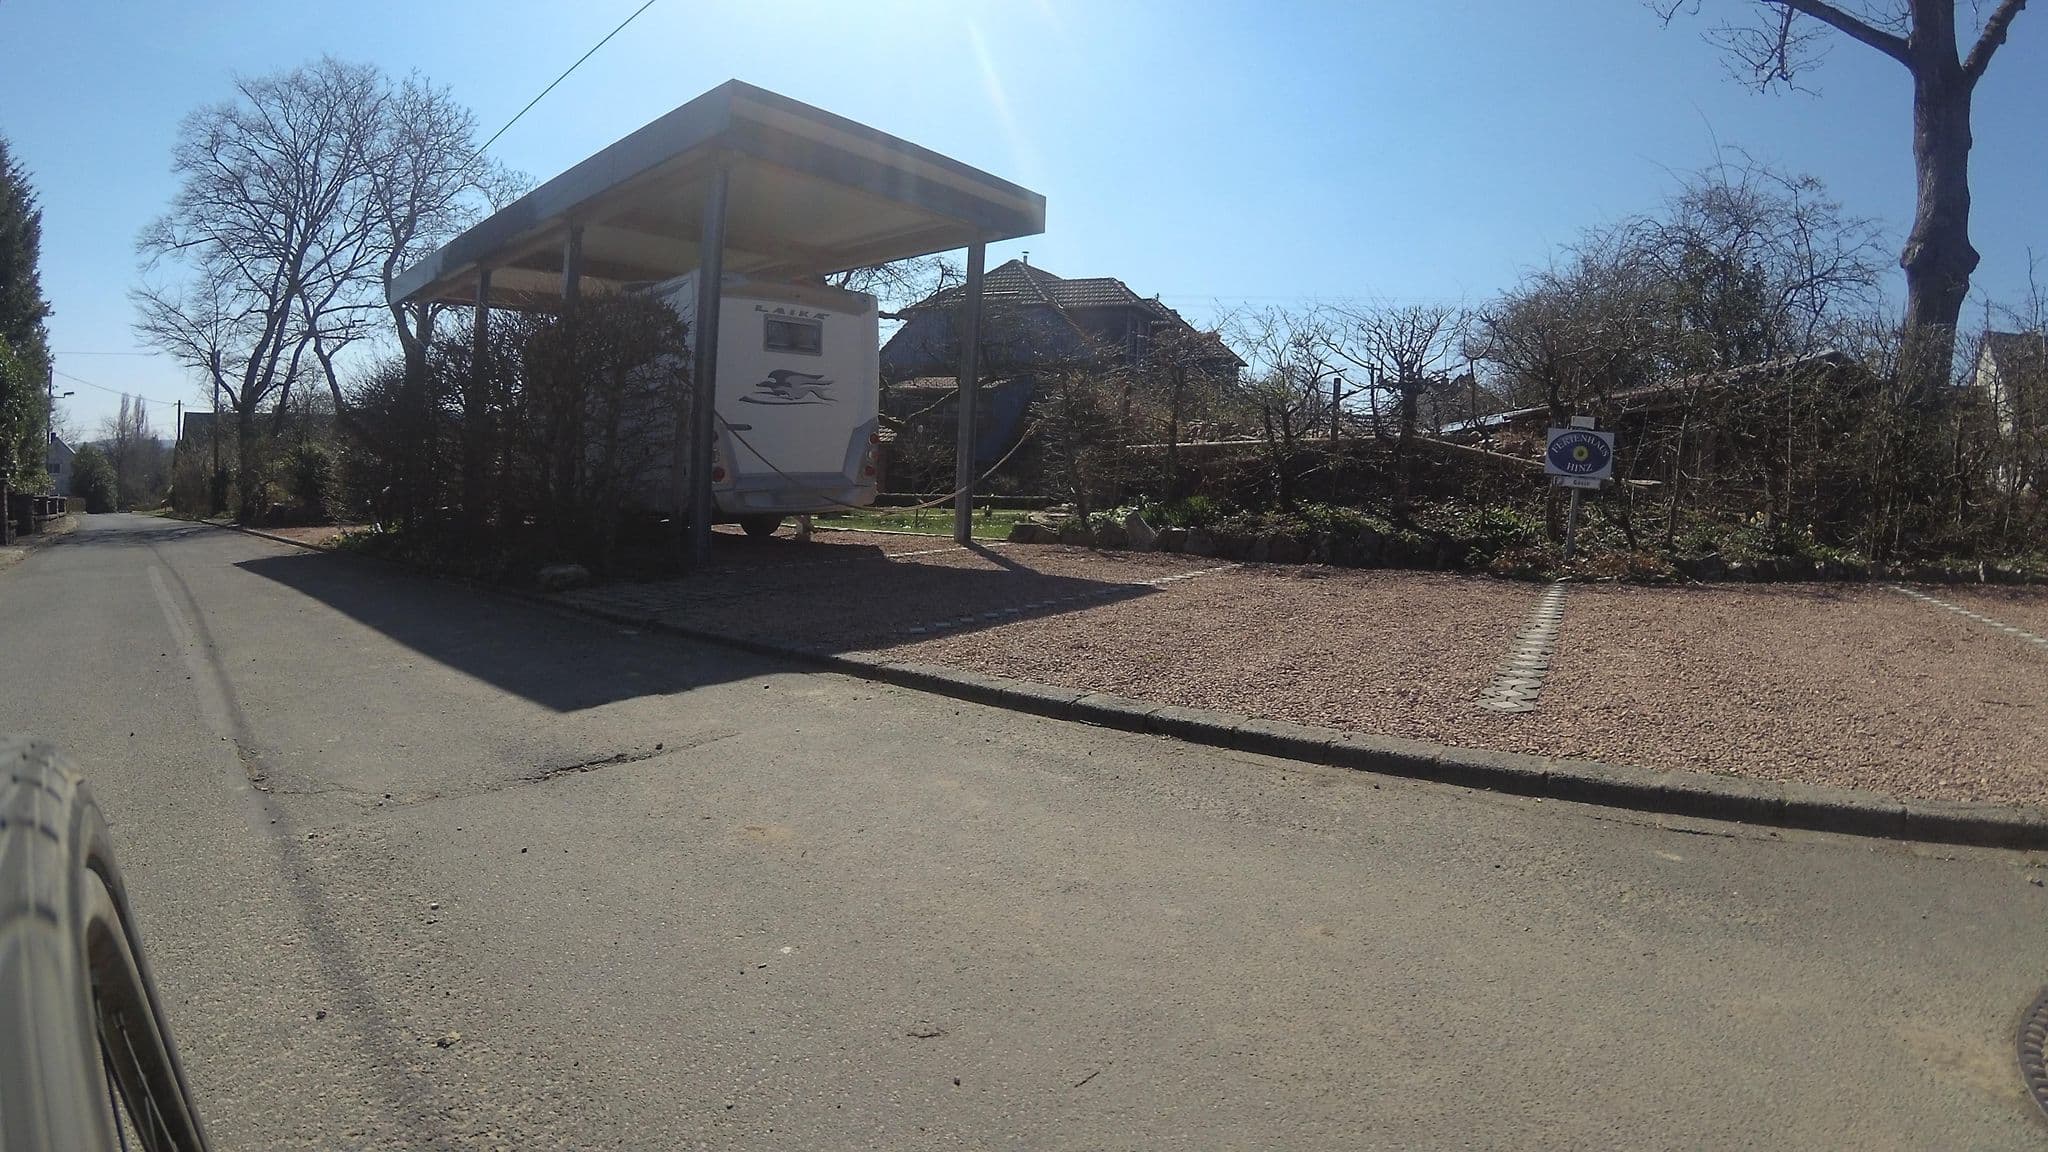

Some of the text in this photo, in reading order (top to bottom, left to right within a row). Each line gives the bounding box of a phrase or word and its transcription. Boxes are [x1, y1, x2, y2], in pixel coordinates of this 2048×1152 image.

[754, 304, 831, 320] LAIKA
[1551, 433, 1609, 457] FERIENHAUS
[1566, 462, 1593, 472] HINZ
